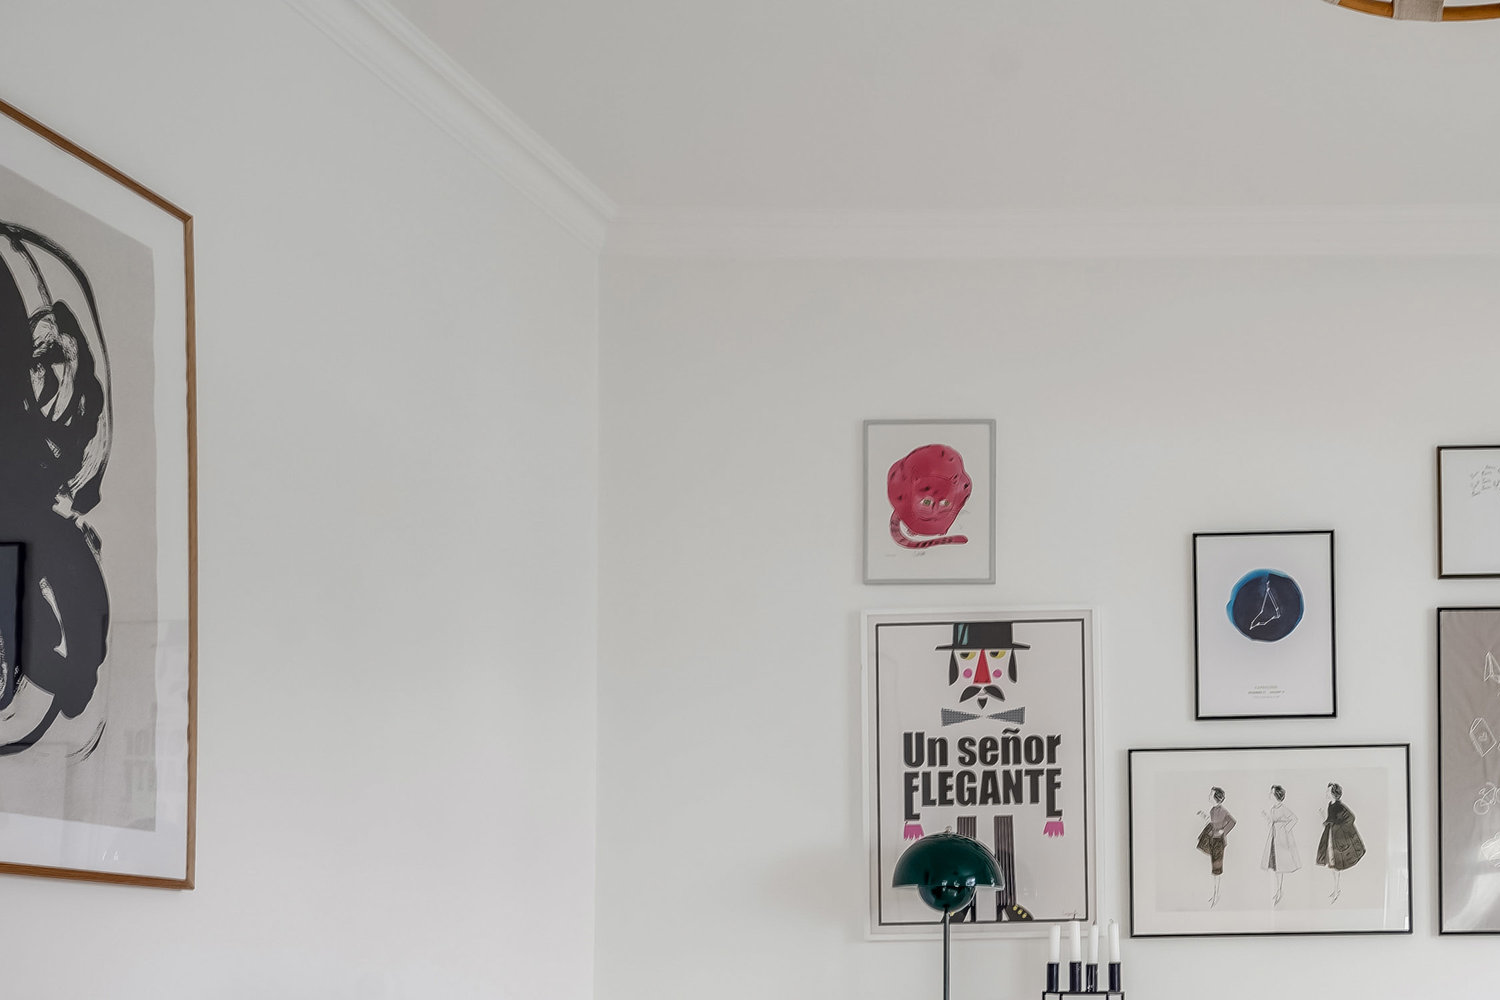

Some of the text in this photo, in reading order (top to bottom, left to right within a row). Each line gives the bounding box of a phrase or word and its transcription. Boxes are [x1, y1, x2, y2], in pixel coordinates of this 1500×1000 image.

[903, 727, 1062, 768] Un señor
[903, 768, 1064, 821] ELEGANTE
